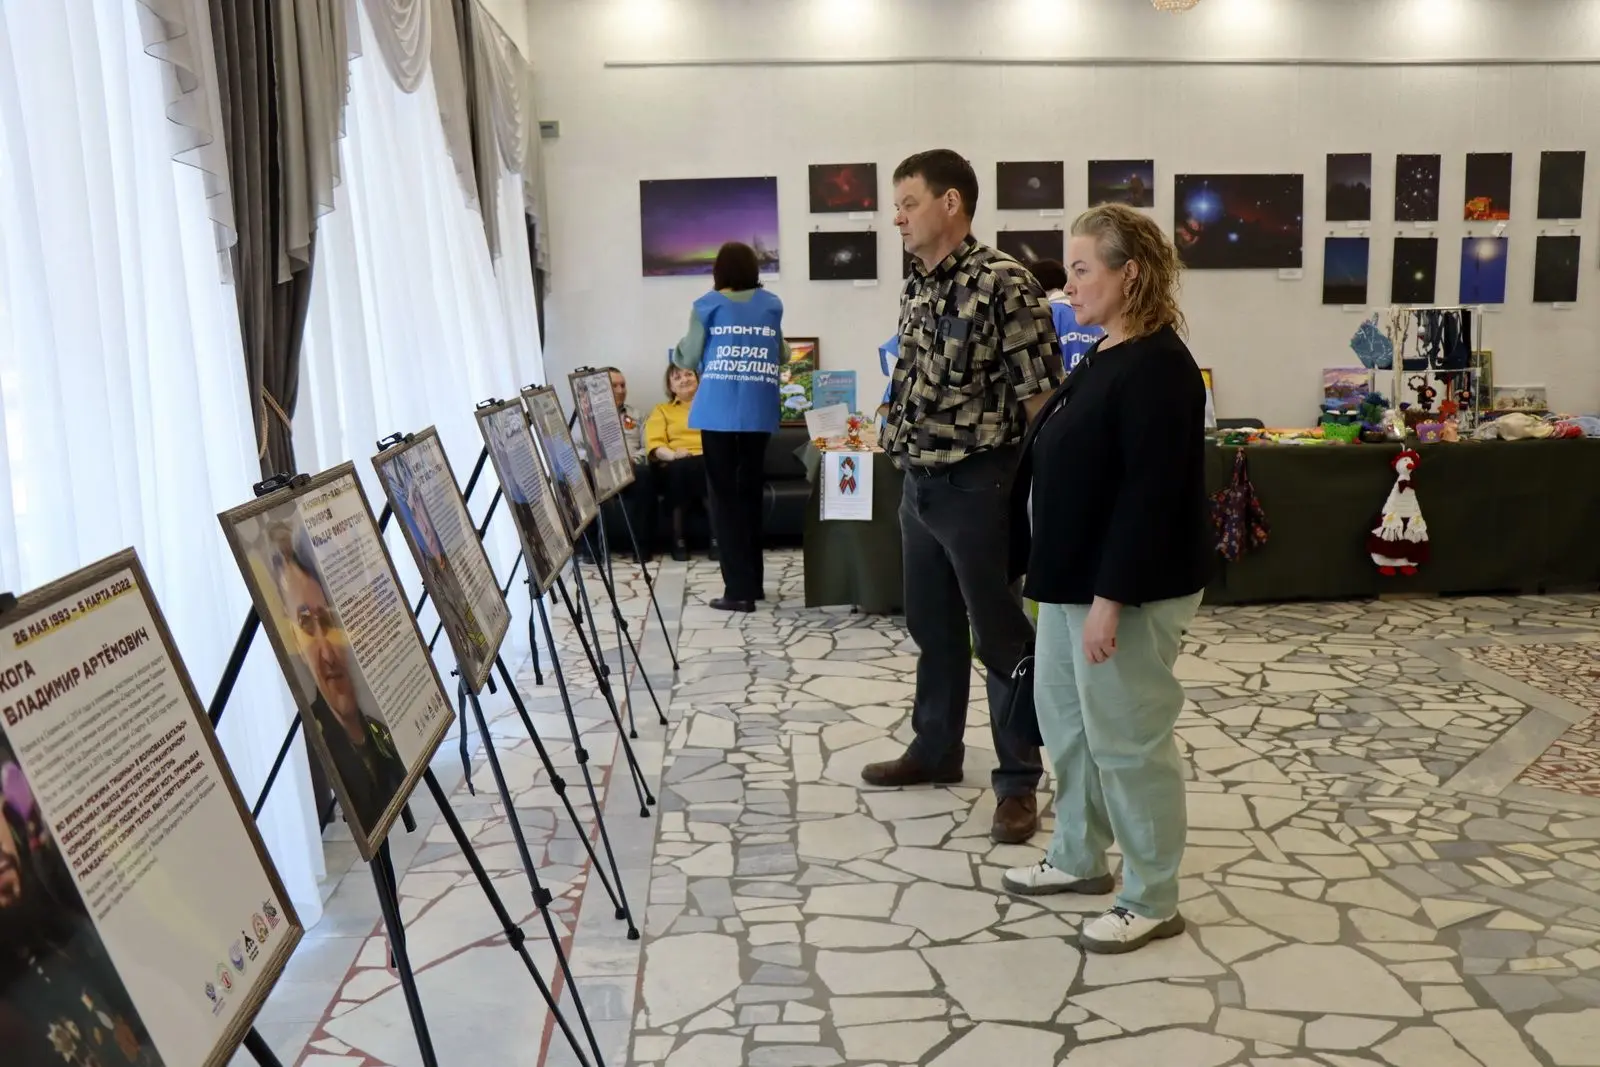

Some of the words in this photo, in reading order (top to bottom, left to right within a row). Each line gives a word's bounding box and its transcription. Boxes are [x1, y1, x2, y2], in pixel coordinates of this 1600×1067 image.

[716, 346, 768, 359] ДОБРАЯ
[13, 629, 28, 646] 26
[28, 618, 50, 638] МАЯ
[48, 608, 71, 627] 1993
[84, 589, 113, 610] МАРТА
[110, 578, 132, 596] 2022
[3, 666, 81, 727] ВЛАДИМИР
[82, 626, 150, 680] АРТЁМОВИЧ
